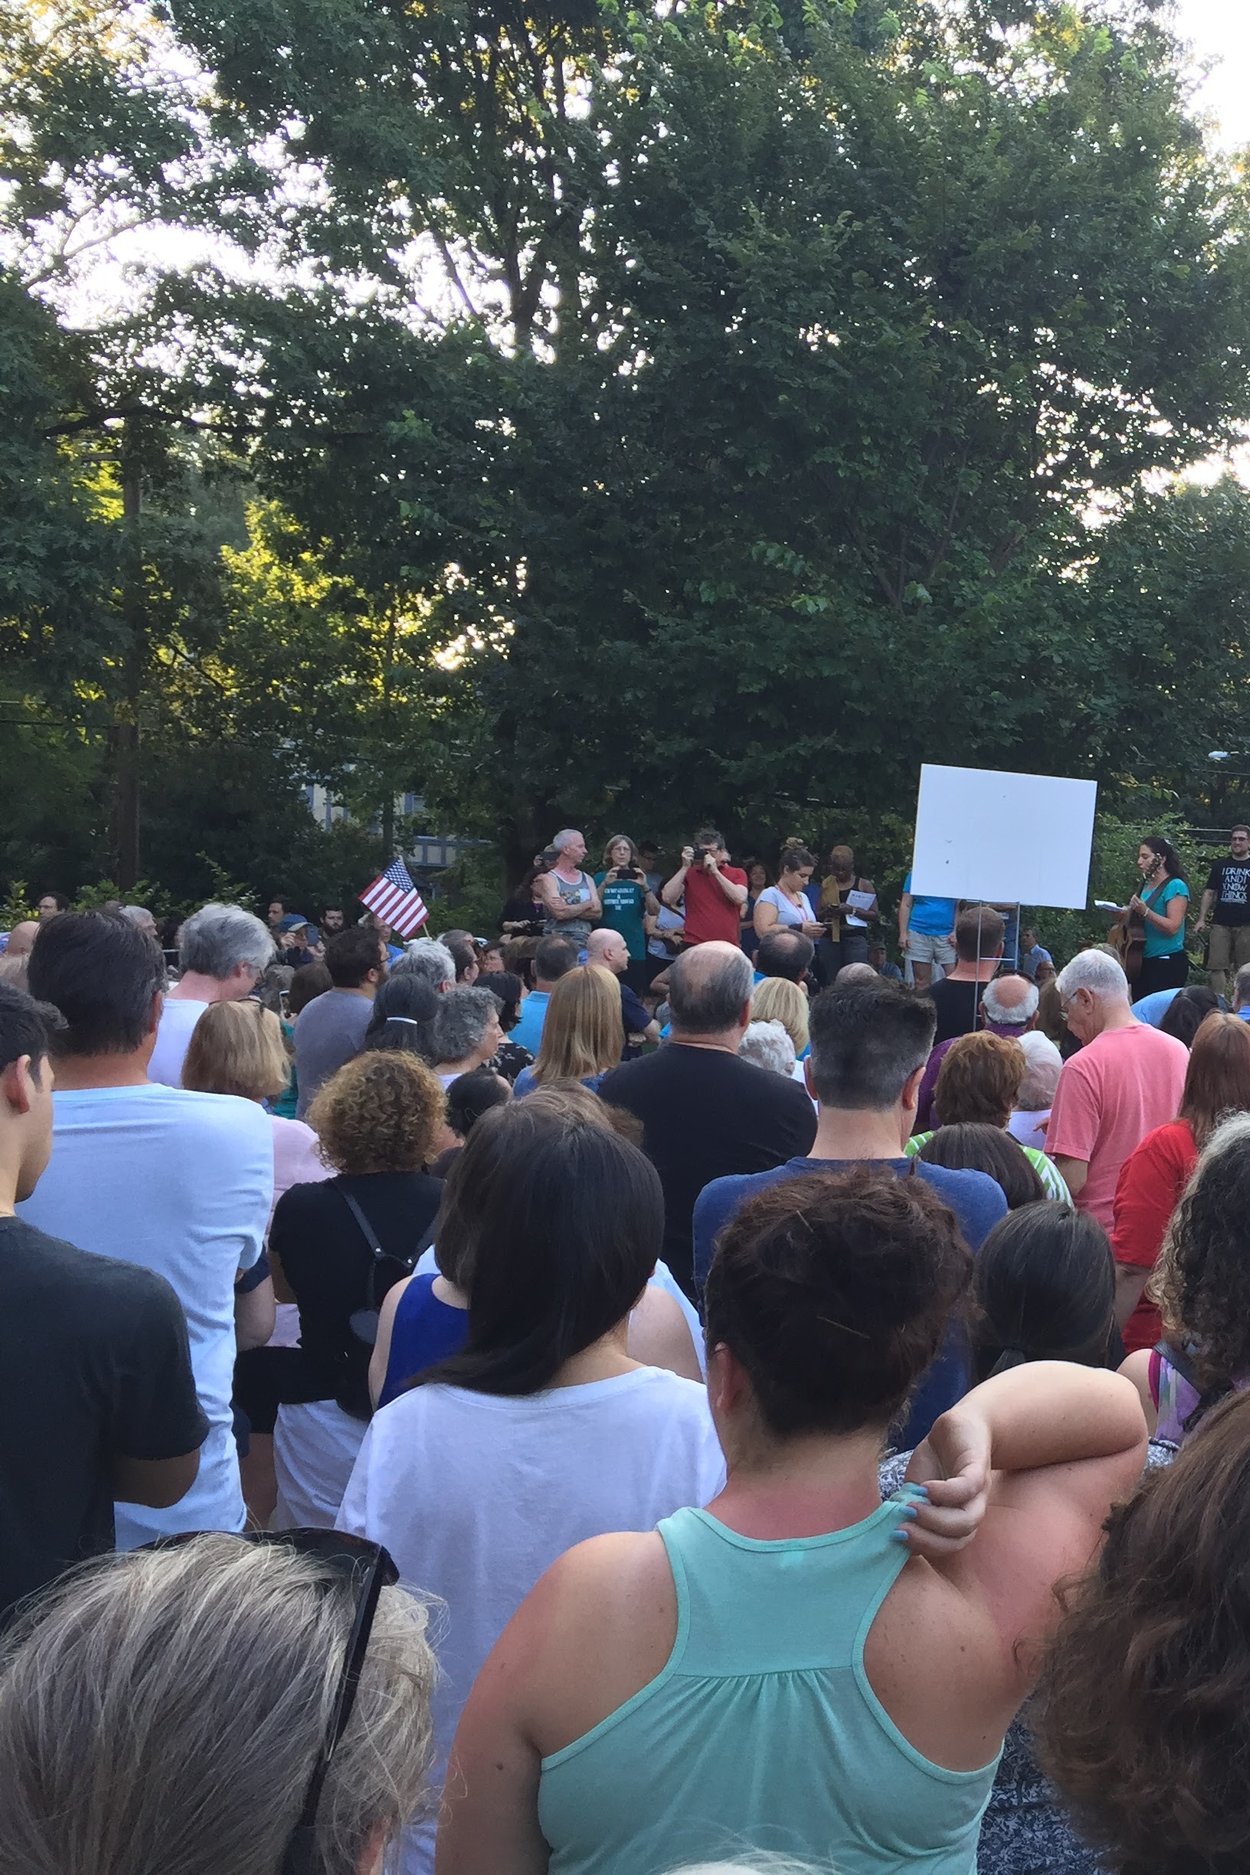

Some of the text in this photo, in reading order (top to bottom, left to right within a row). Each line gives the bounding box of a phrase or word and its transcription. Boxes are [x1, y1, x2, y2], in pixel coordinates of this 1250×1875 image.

[1225, 867, 1250, 877] DRINK
[1224, 875, 1243, 884] AND
[1222, 883, 1248, 891] KNOW
[1221, 890, 1247, 899] THINGS
